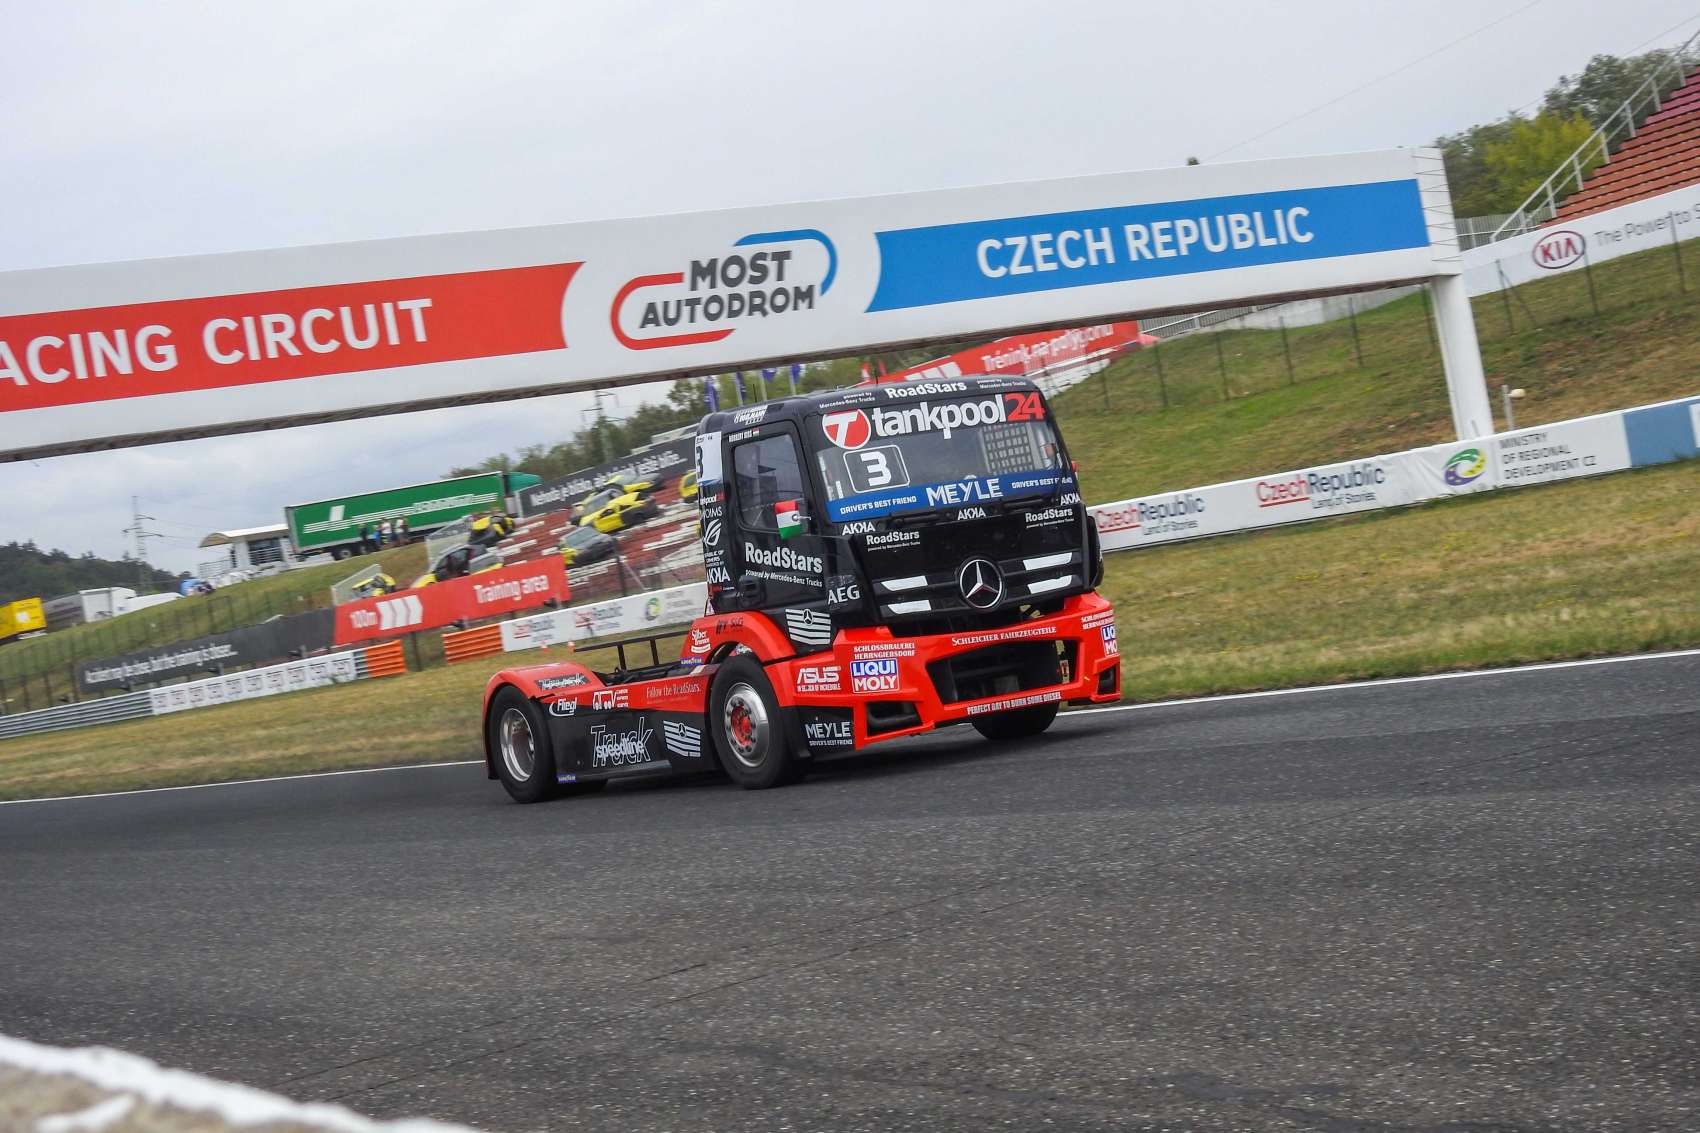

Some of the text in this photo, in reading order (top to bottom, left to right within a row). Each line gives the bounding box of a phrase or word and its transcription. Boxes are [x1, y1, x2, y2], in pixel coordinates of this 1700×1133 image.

[977, 206, 1315, 278] CZECH REPUBLIC
[1594, 230, 1622, 246] The
[1540, 237, 1579, 264] KIA
[689, 250, 792, 291] MOST
[639, 284, 816, 329] AUTODROM
[202, 298, 433, 366] CIRCUIT
[884, 381, 967, 399] RoadStars
[871, 391, 1046, 440] tankpool24
[1501, 432, 1547, 449] MINISTRY
[1503, 444, 1572, 465] OF REGIONAL
[860, 451, 892, 487] 3
[1505, 455, 1597, 479] DEVELOPMENT CZ
[925, 478, 1003, 507] MEYLE
[1011, 478, 1039, 489] DRIVER'S
[1040, 477, 1054, 486] BEST
[840, 495, 917, 515] DRIVER'S BEST FRIEND
[957, 506, 987, 521] AKKA
[1025, 508, 1073, 522] RoadStars
[842, 521, 876, 535] AKKA
[866, 531, 920, 545] RoadStars
[745, 541, 823, 573] RoadStars
[745, 569, 823, 587] powered by Mercedes-Benz Trucks
[473, 575, 549, 603] Training area
[827, 584, 860, 605] AEG
[952, 626, 1056, 646] SCHLEICHER FAHRZEUGTEILE
[853, 642, 915, 652] SCHLOSSBRAUEREI
[854, 649, 915, 660] HERRNGIERSDORF
[797, 666, 840, 684] ASUS
[853, 660, 896, 676] LIQUI
[854, 675, 897, 692] MOLY
[557, 697, 577, 713] Fliegl
[805, 721, 852, 738] MEYLE
[591, 716, 653, 767] Truck
[596, 737, 644, 761] speedline
